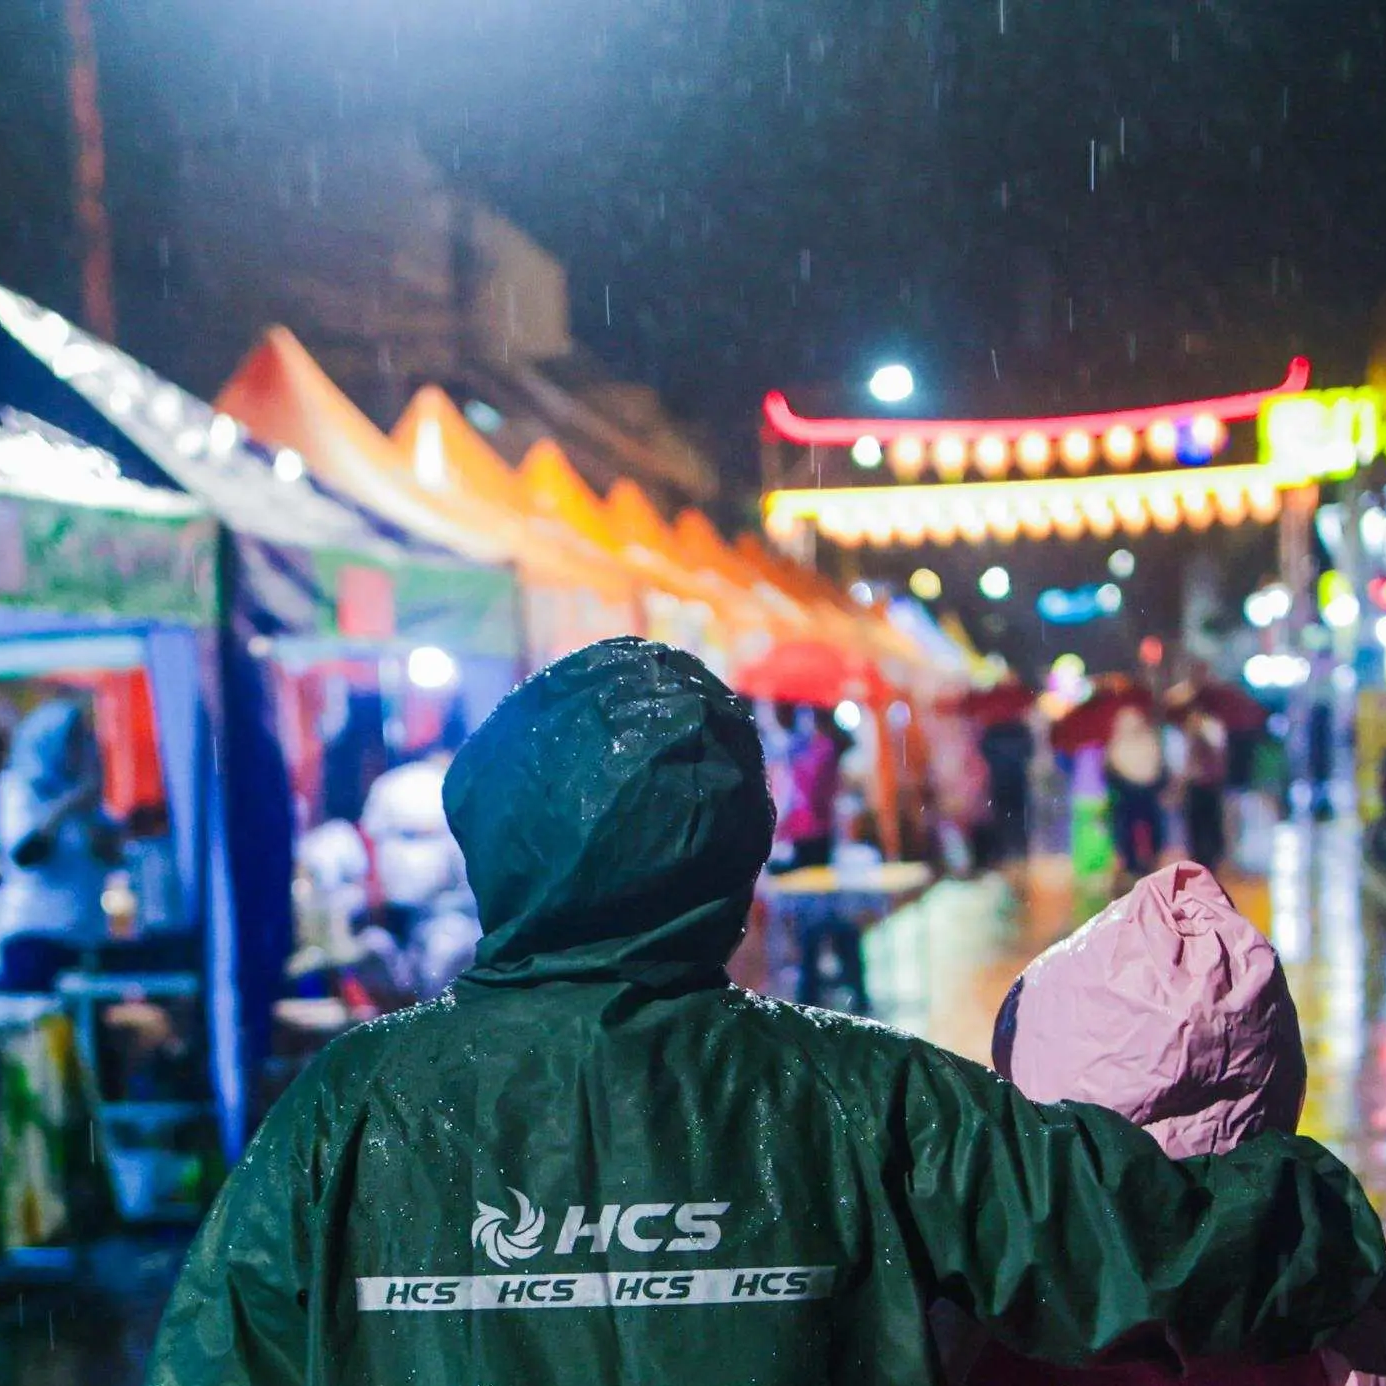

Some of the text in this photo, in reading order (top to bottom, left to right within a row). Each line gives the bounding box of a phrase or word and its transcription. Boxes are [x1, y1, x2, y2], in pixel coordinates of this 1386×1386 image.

[554, 1202, 731, 1254] HCS
[385, 1272, 811, 1304] HCS HCS HCS HCS
